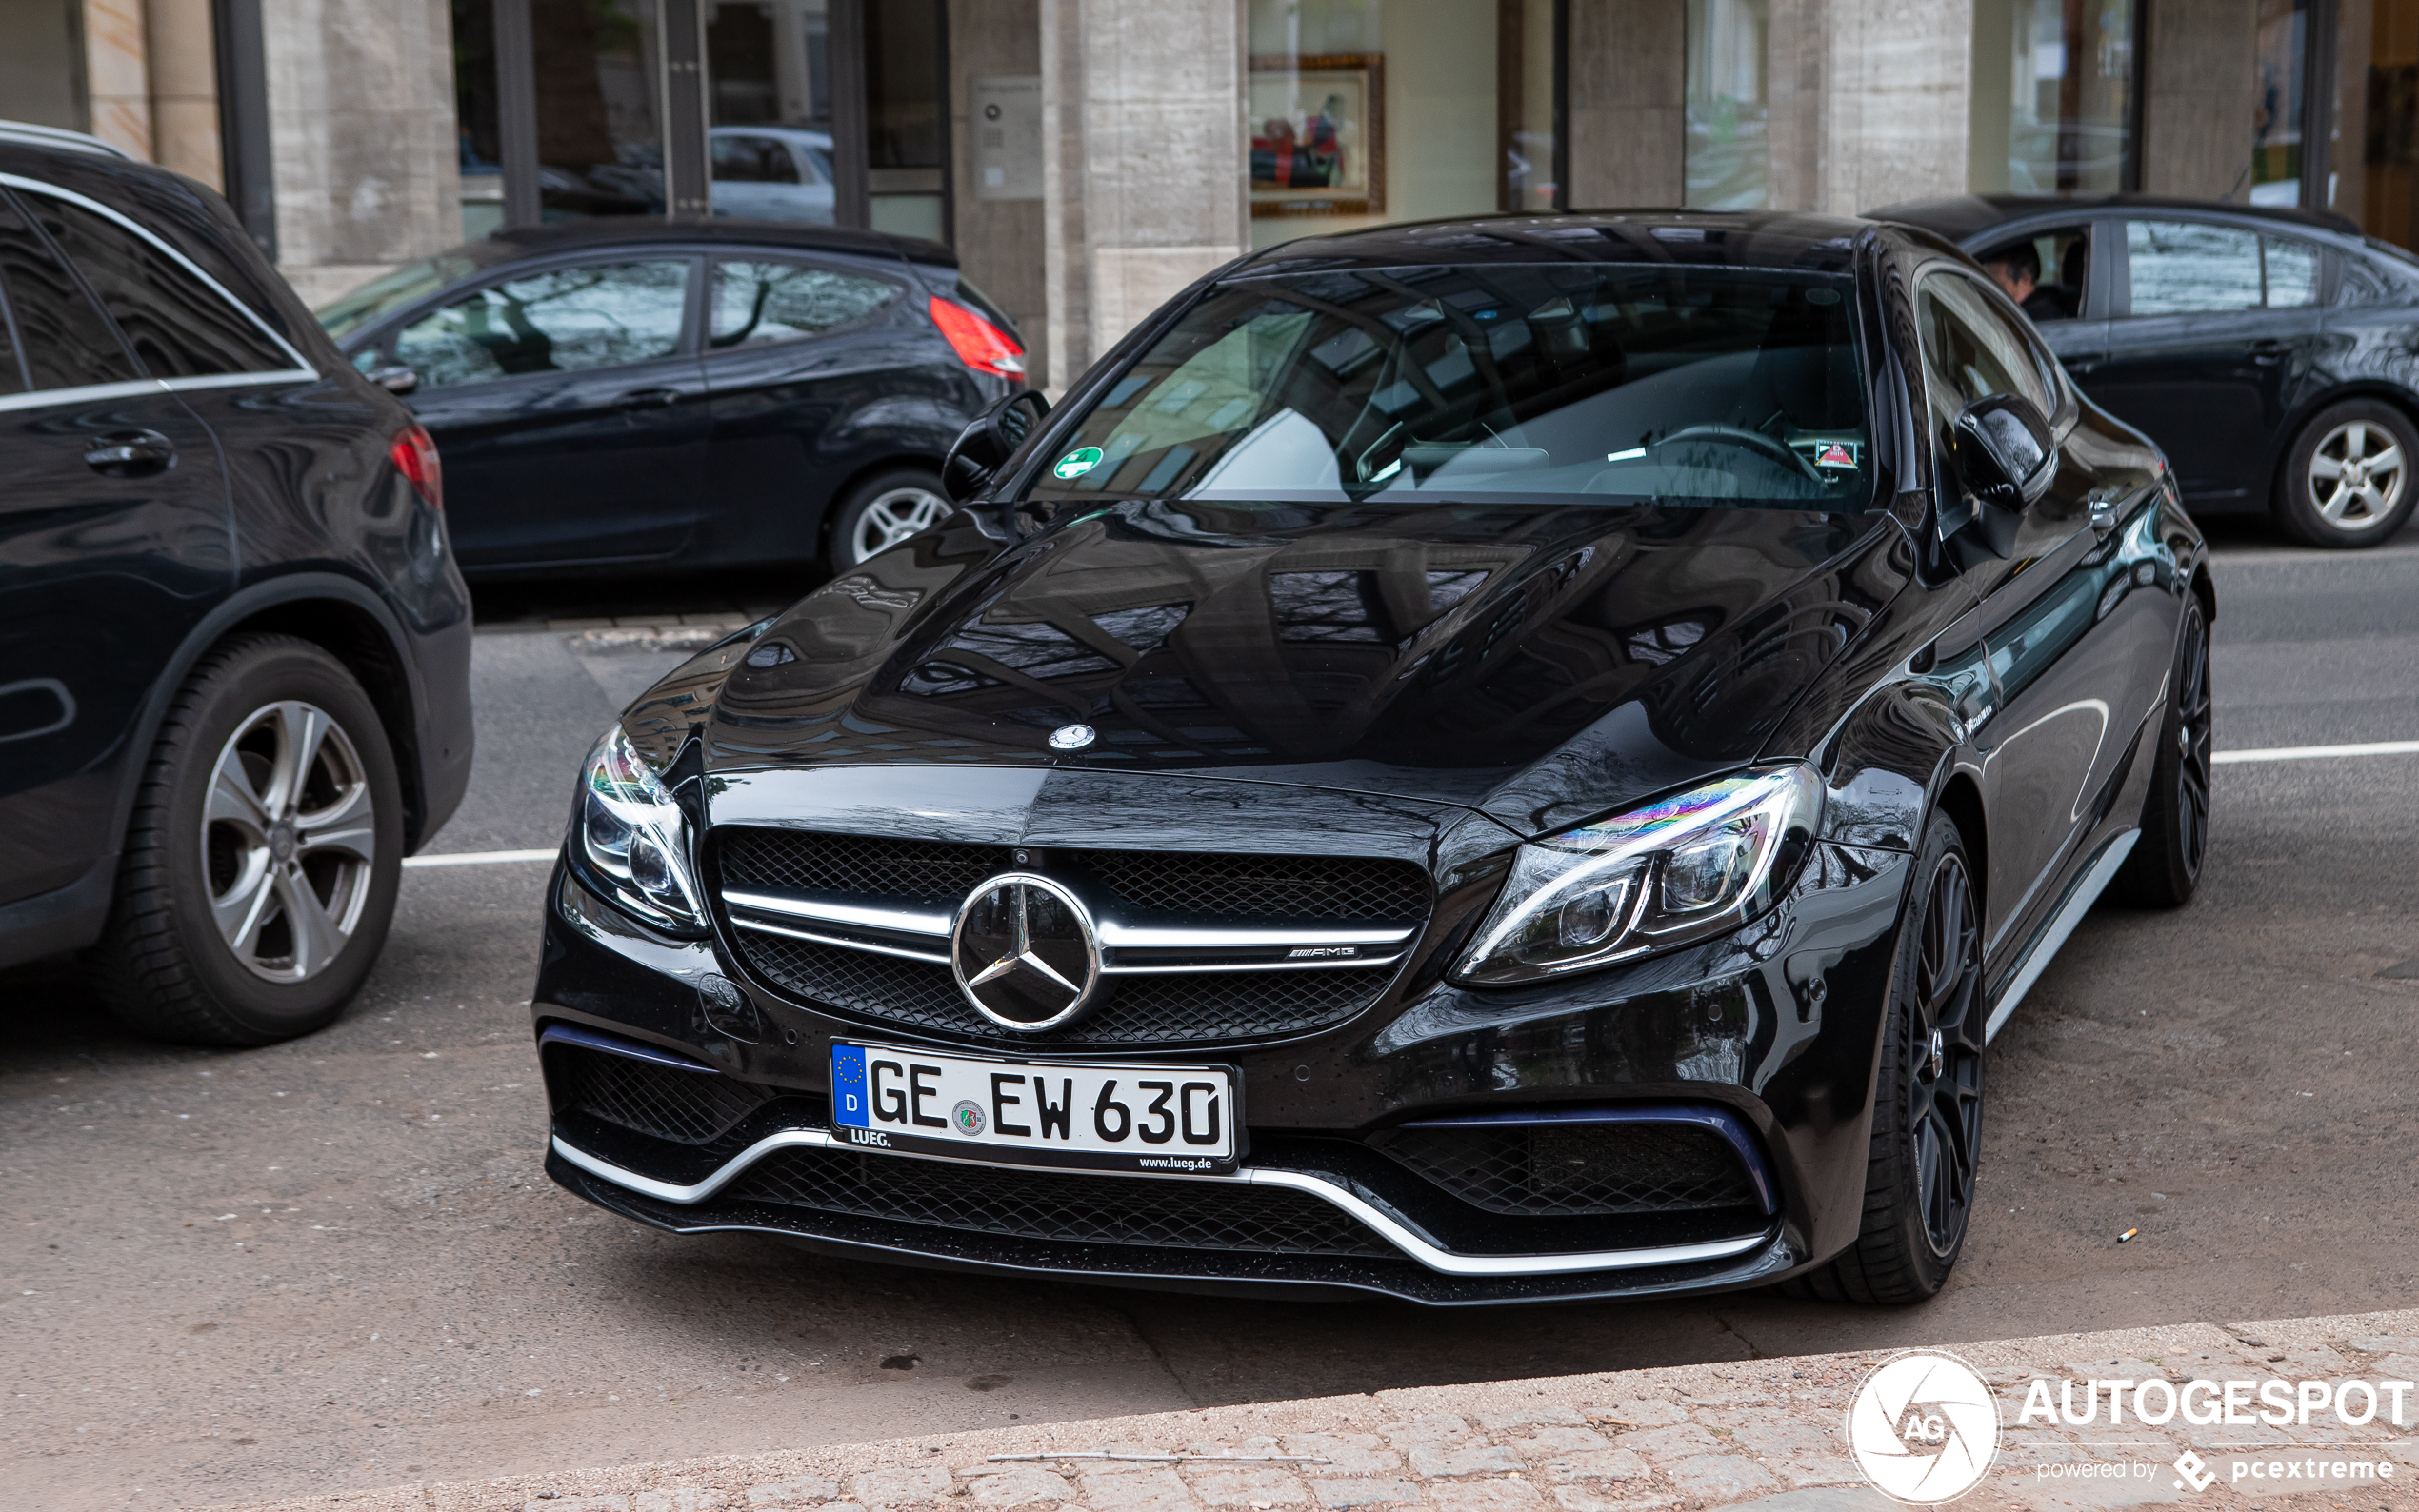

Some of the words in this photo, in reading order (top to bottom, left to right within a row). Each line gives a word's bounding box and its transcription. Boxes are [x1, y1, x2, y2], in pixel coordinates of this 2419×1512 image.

[1310, 947, 1354, 956] AMG
[845, 1094, 858, 1112] D
[870, 1059, 949, 1128] GE
[990, 1072, 1072, 1140] EW
[1093, 1079, 1221, 1145] 630
[850, 1129, 891, 1148] LUEG.
[1140, 1156, 1212, 1171] www.lueg.de
